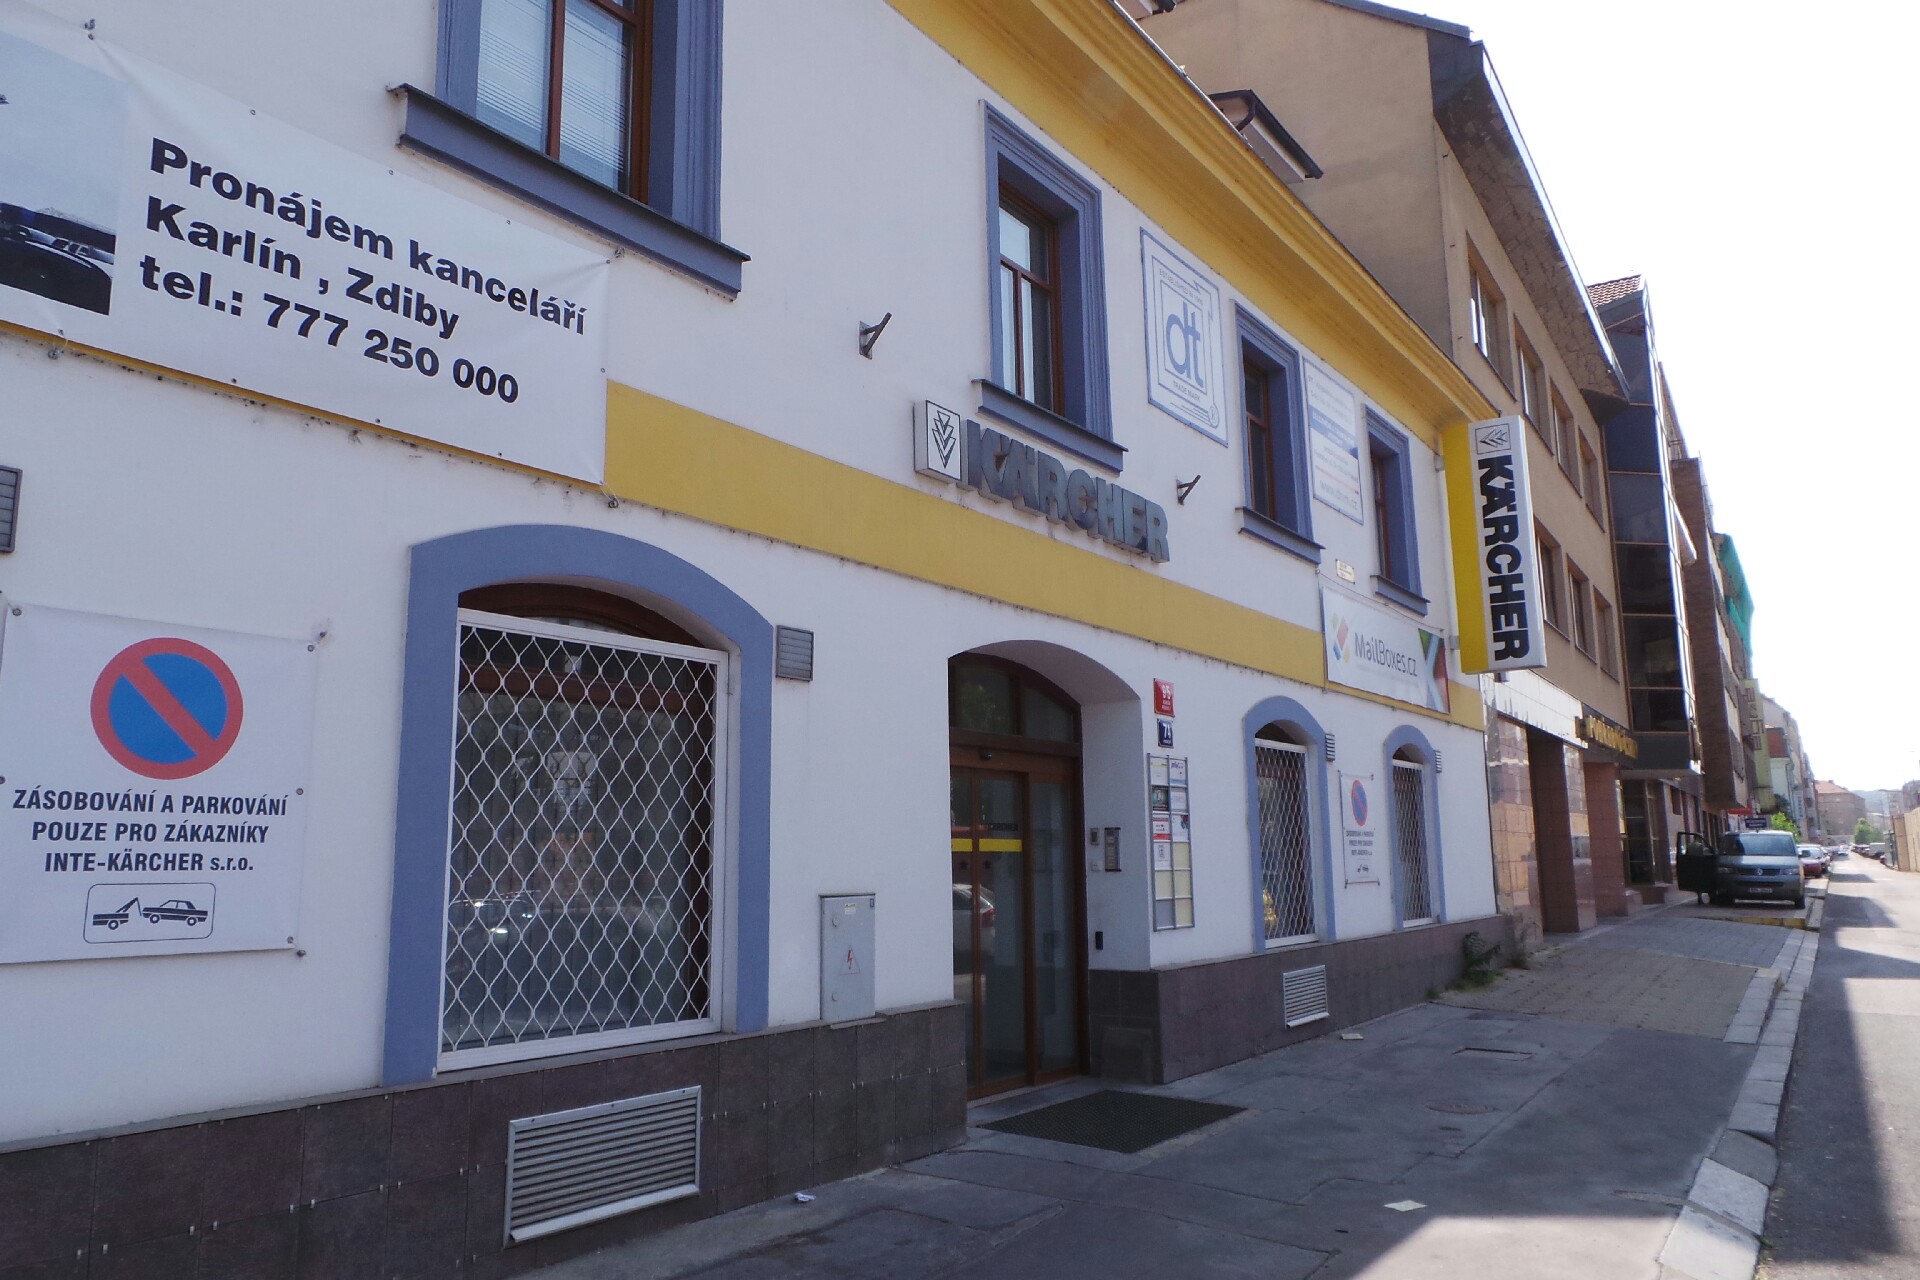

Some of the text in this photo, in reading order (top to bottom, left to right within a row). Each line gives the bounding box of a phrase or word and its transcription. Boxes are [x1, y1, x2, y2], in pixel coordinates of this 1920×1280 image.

[147, 196, 301, 280] Karlín
[346, 267, 459, 339] Zdiby
[151, 138, 587, 335] Pronájem kanceláří
[140, 255, 518, 403] tel.: 777 250 000
[1166, 301, 1204, 388] dt
[966, 419, 1170, 563] KÄRCHER
[1478, 455, 1529, 661] KÄRCHER
[1355, 632, 1418, 677] MailBoxes.cz
[13, 785, 288, 815] ZÁSOBOVÁNÍ A PARKOVÁNÍ
[32, 820, 269, 843] POUZE PRO ZÁKAZNÍKY
[45, 849, 254, 871] INTE-KÄRCHER s.r.o.
